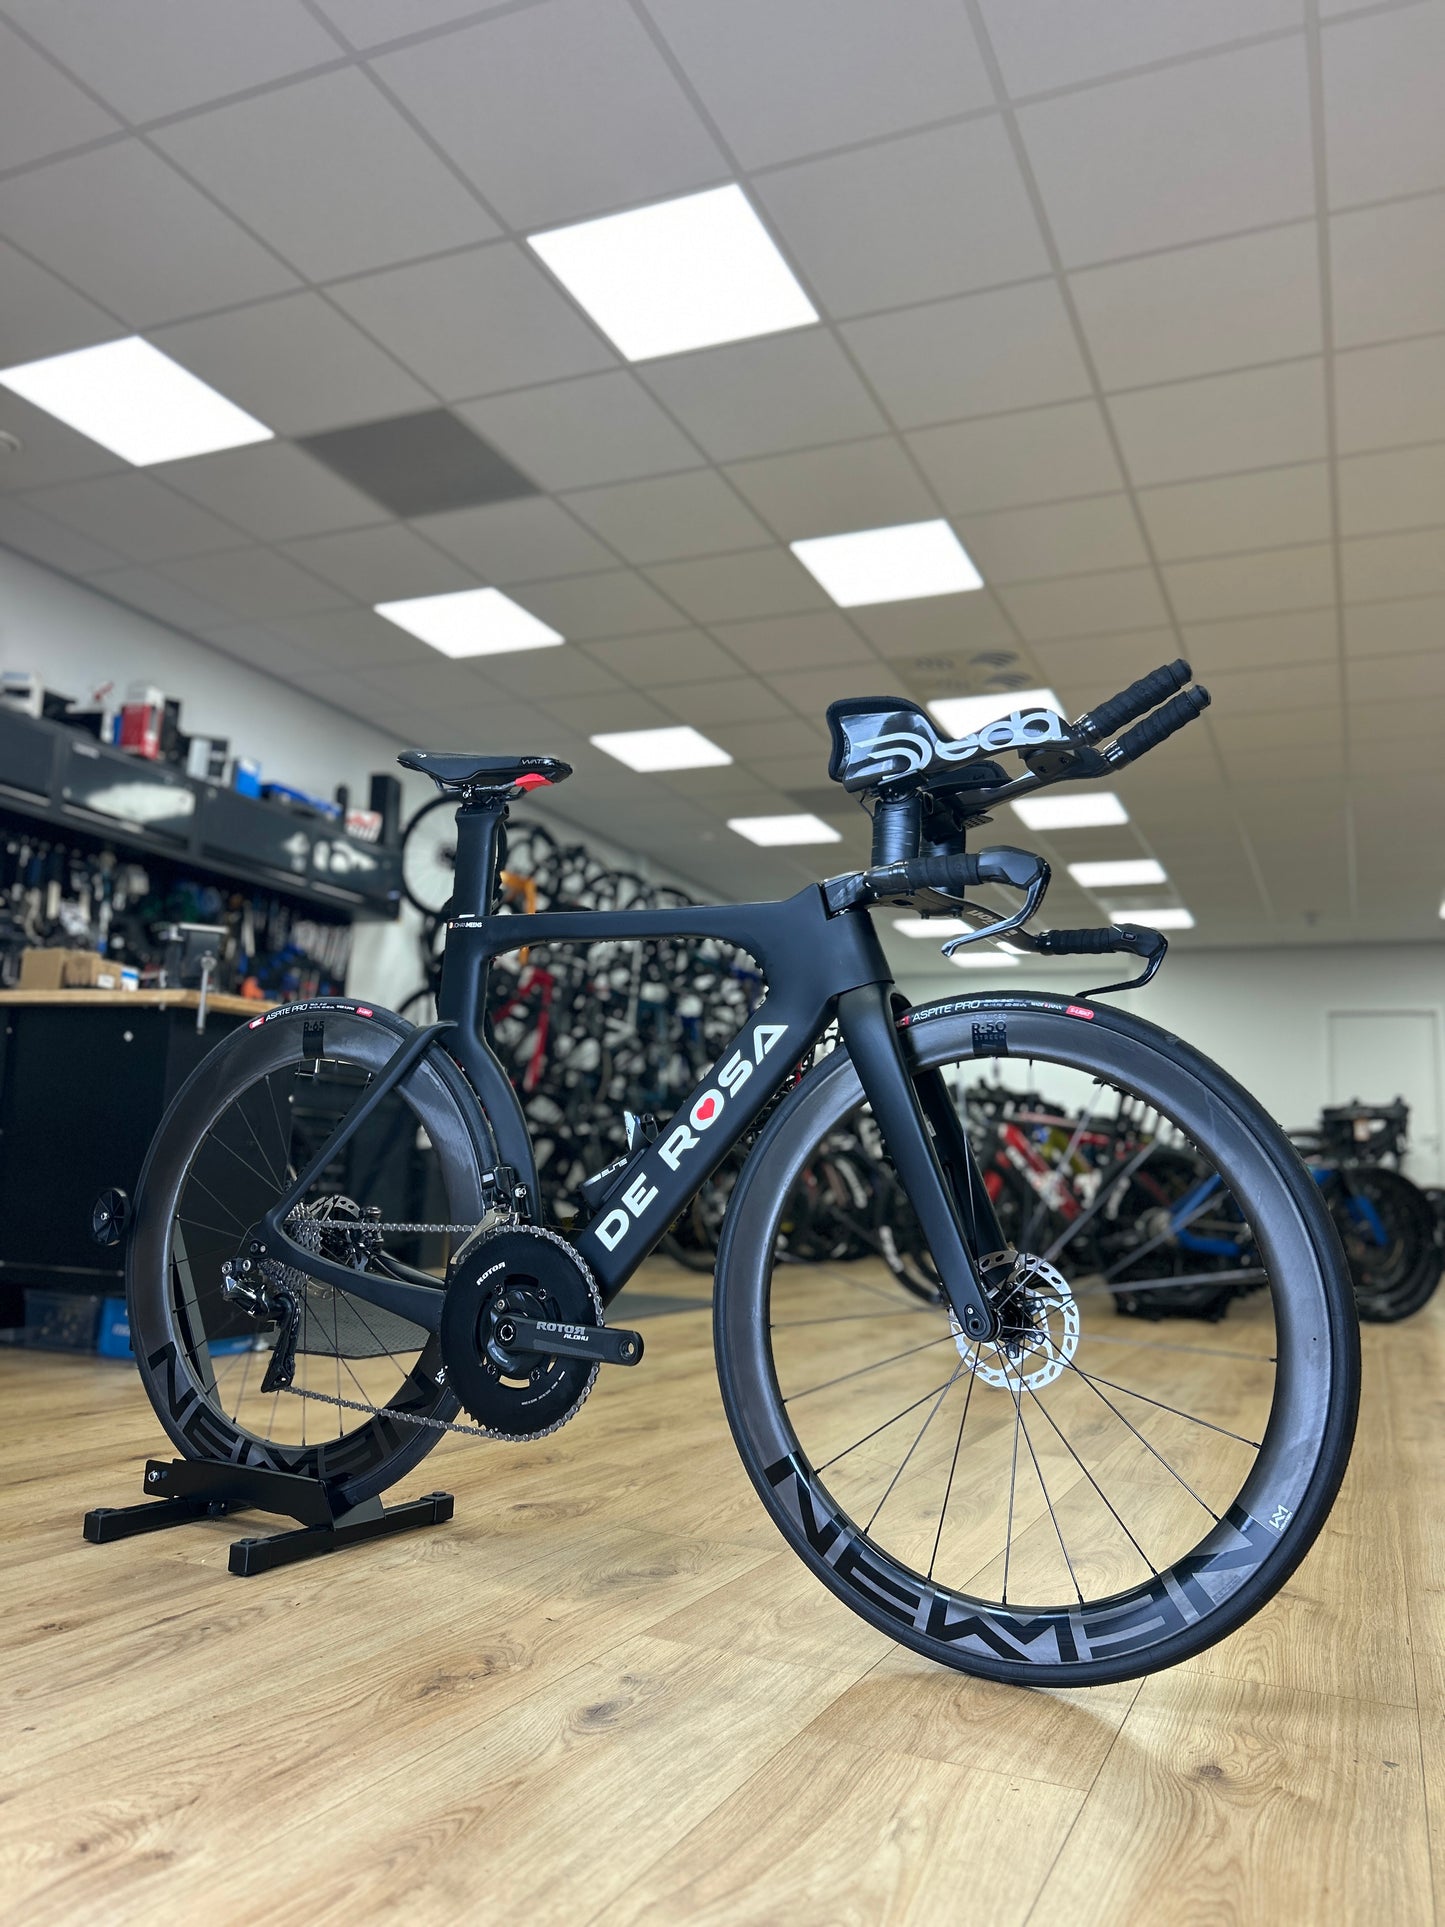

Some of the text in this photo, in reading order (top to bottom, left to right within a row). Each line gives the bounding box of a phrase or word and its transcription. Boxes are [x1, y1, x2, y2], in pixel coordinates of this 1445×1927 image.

[265, 1007, 291, 1021] ASPITE
[292, 1003, 308, 1013] PRO
[912, 1003, 951, 1022] ASPITE
[954, 1000, 980, 1011] PRO
[594, 1172, 659, 1252] DE
[658, 1024, 789, 1171] ROSA
[476, 1261, 506, 1286] ROTOR
[536, 1321, 586, 1335] ROTOR
